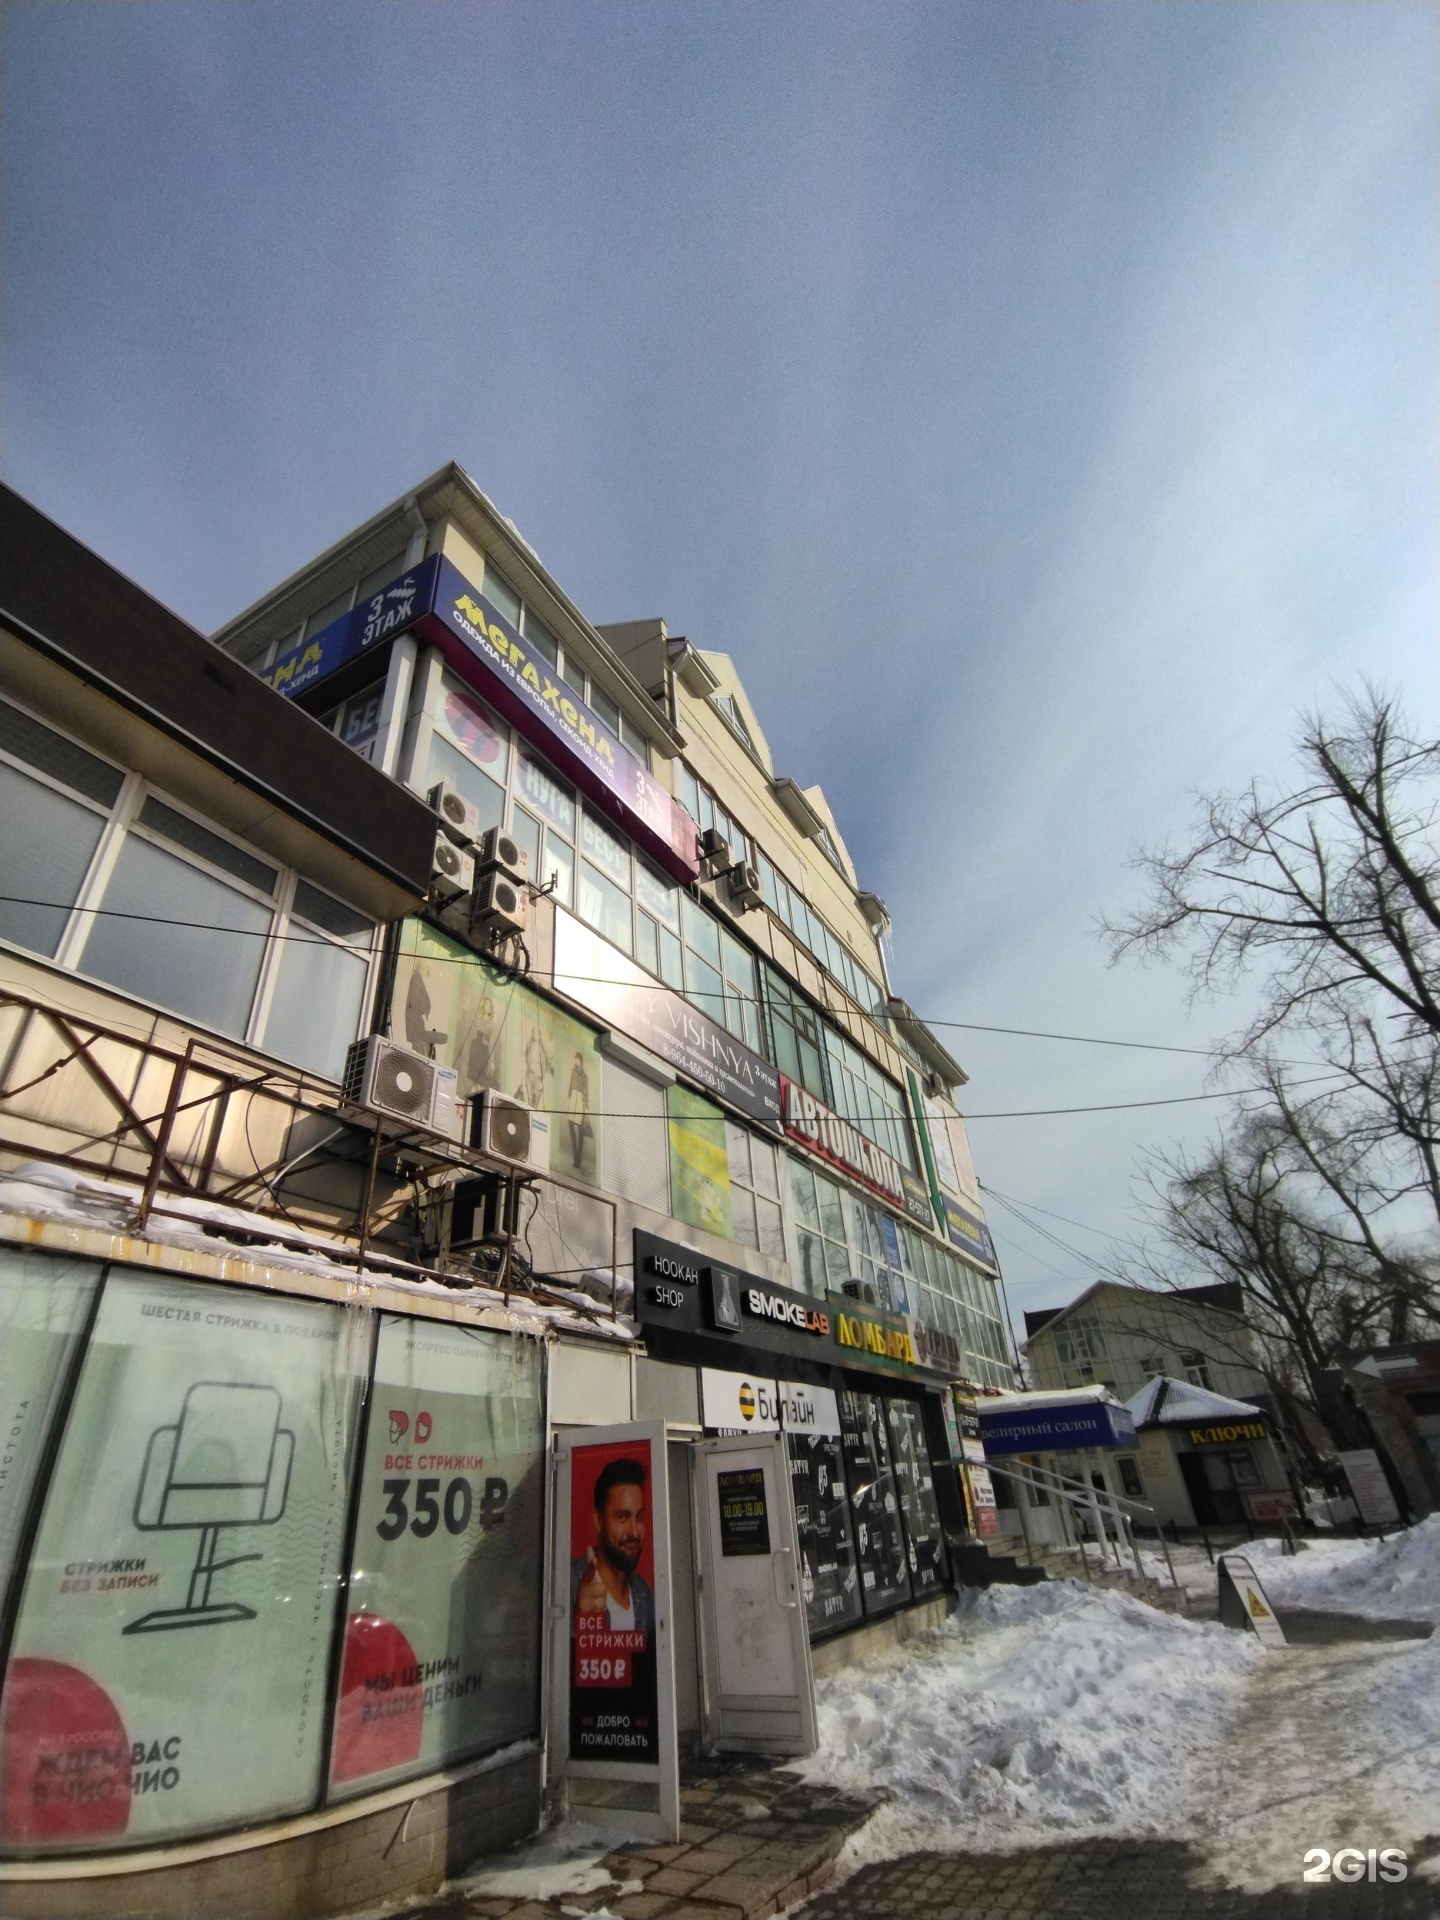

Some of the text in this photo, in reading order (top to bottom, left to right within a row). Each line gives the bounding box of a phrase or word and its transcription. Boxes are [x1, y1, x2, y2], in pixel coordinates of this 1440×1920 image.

[362, 596, 415, 646] ЭТАЖ
[367, 594, 384, 623] 3
[453, 610, 616, 781] ОДЕЖДА ИЗ ЕВРОПЫ, СЕКОНД-ХЕНД
[636, 771, 645, 794] 3
[666, 1000, 754, 1085] VISHNYA
[785, 1082, 902, 1202] АВТОШКОЛА
[654, 1255, 699, 1285] HOOKAH
[655, 1285, 684, 1308] SHOP
[140, 1303, 202, 1323] ШЕСТАЯ
[205, 1313, 269, 1333] СТРИЖКА
[836, 1313, 916, 1366] ЛОМБАРД
[981, 1418, 1098, 1441] велирный салон
[1189, 1423, 1267, 1444] КЛЮЧИ
[384, 1454, 485, 1471] ВСЕ СТРИЖКИ
[64, 1558, 147, 1576] СТРИЖКИ
[96, 1573, 160, 1591] ЗАПИСИ
[579, 1616, 603, 1630] ВСЕ
[579, 1634, 644, 1649] СТРИЖКИ
[402, 1655, 460, 1688] ЦЕНИМ
[424, 1672, 482, 1710] ДЕНЬГИ
[596, 1714, 631, 1729] ДОБРО
[131, 1736, 182, 1767] ВАС
[581, 1732, 649, 1748] ПОЖАЛОВАТЬ
